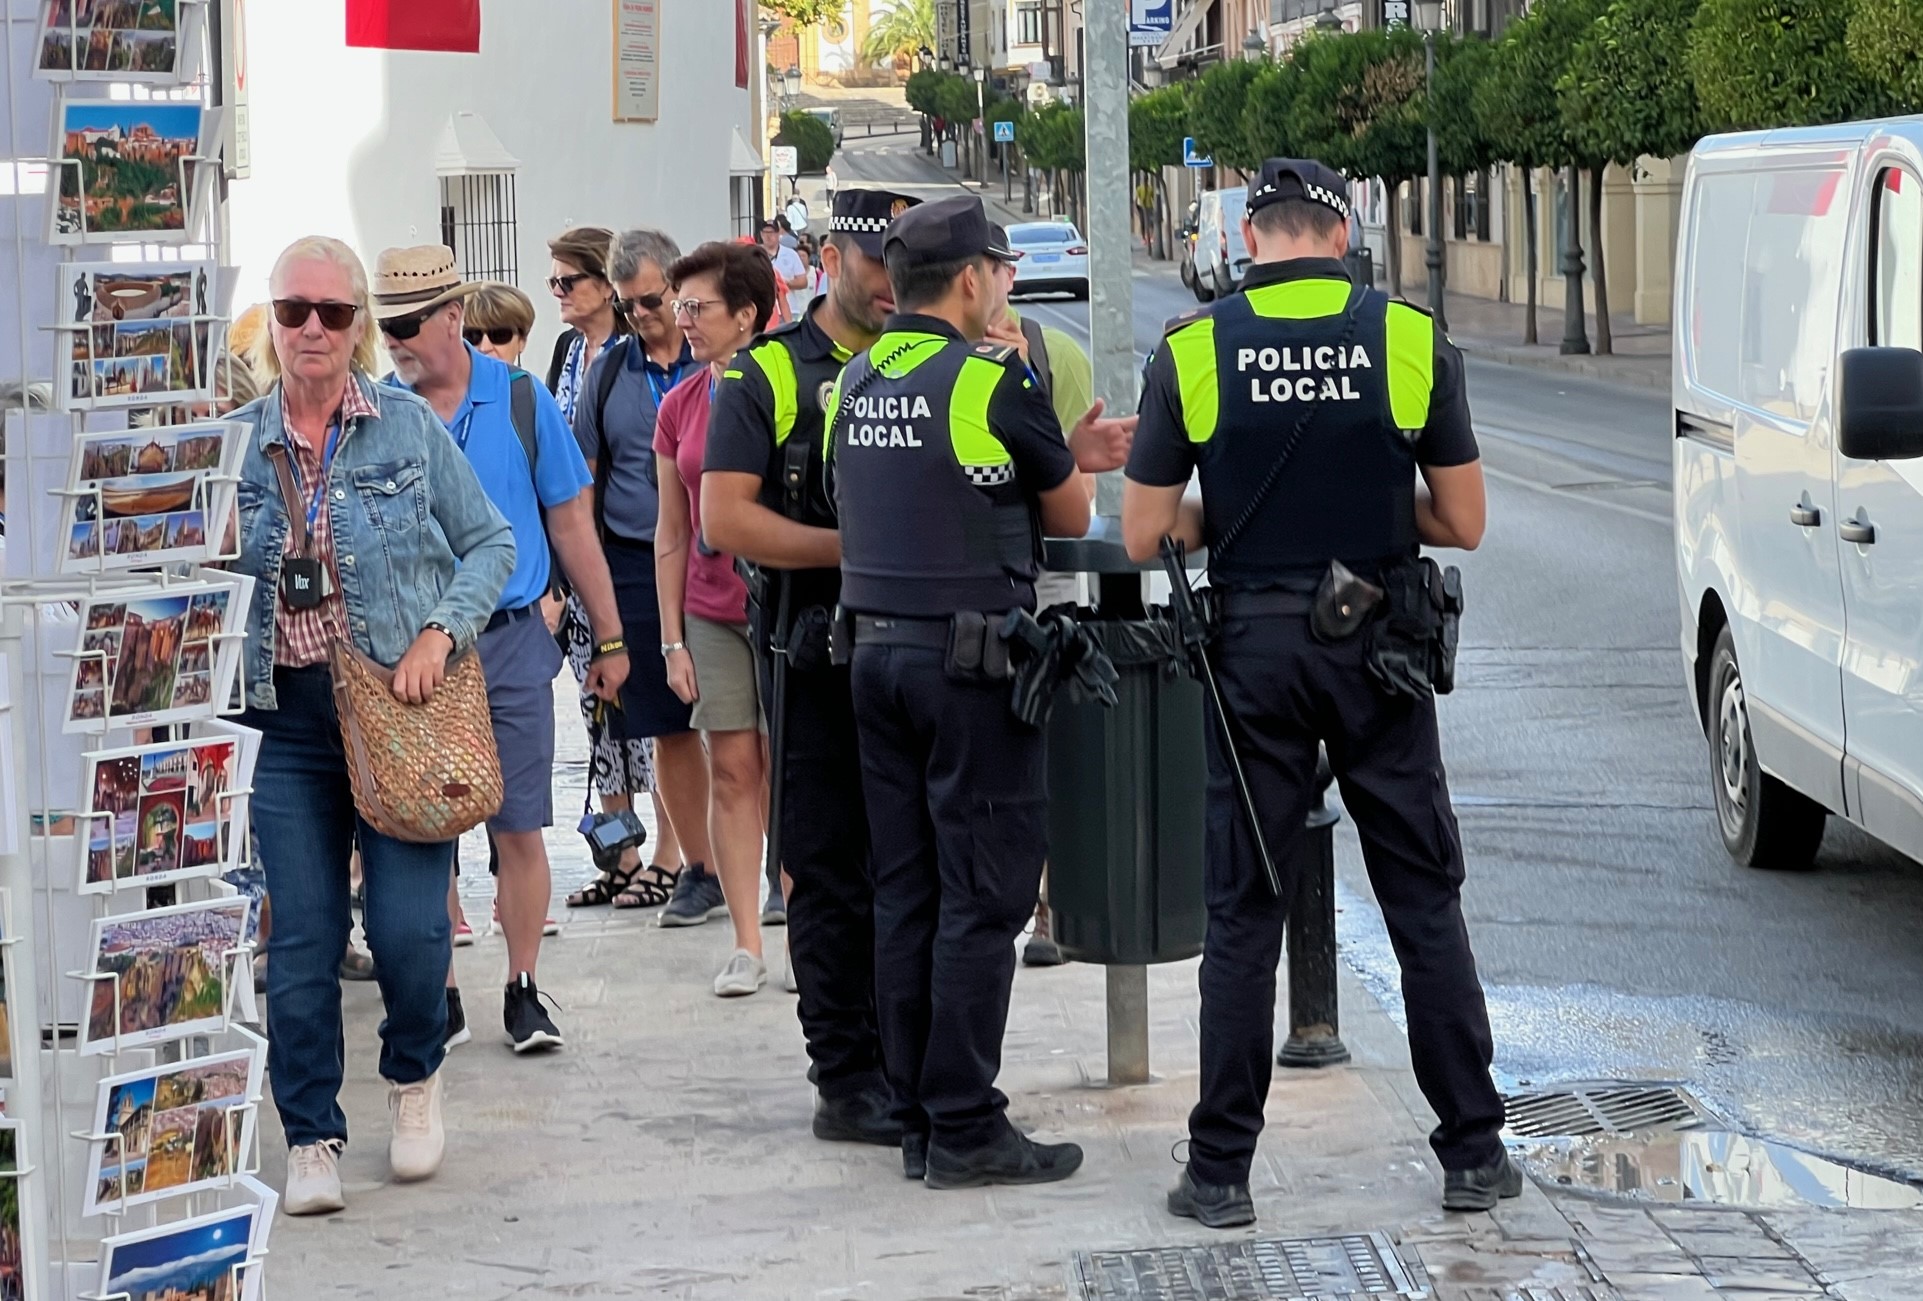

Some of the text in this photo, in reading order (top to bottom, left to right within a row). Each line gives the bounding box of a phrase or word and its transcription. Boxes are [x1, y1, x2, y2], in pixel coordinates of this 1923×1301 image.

[1238, 345, 1372, 371] POLICIA
[1251, 376, 1361, 402] LOCAL
[847, 423, 923, 448] LOCAL
